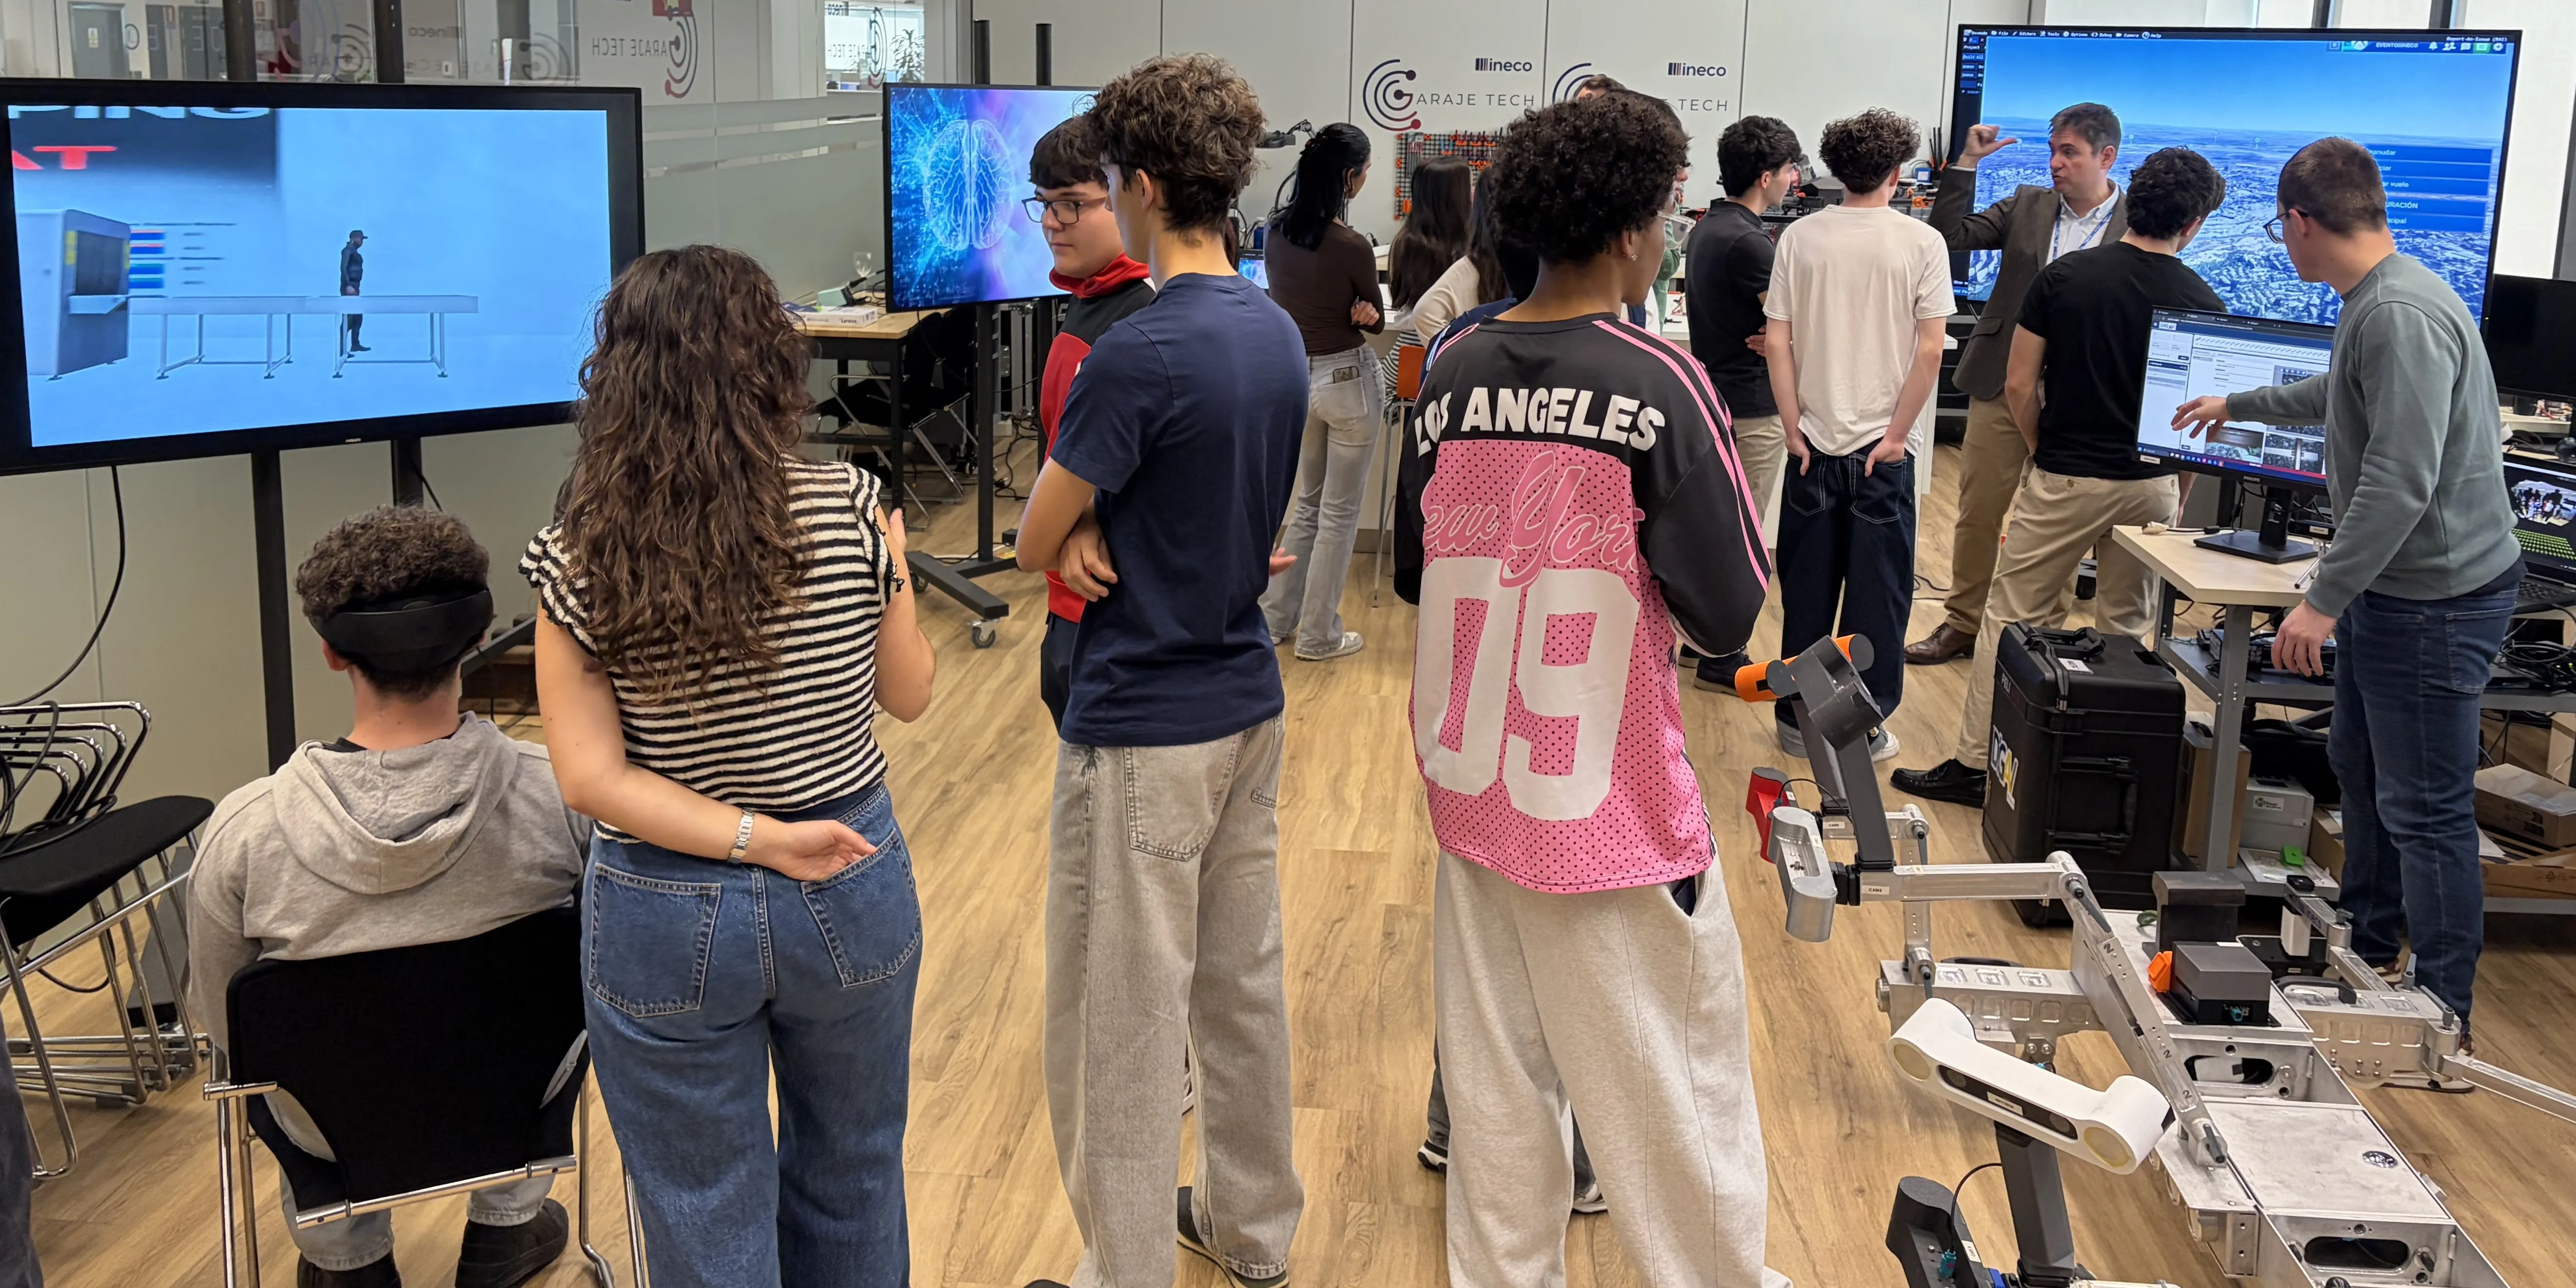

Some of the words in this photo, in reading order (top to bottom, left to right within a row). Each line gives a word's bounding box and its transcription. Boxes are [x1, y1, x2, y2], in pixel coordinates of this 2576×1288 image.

[1489, 58, 1533, 72] ineco
[1682, 62, 1726, 77] ineco
[1486, 94, 1534, 106] TECH
[1678, 99, 1727, 111] TECH
[1414, 392, 1452, 459] LOS
[1460, 387, 1665, 452] ANGELES
[1414, 556, 1641, 822] 09
[2103, 943, 2115, 954] 2
[2163, 1049, 2172, 1059] 2
[2182, 1090, 2193, 1100] 2
